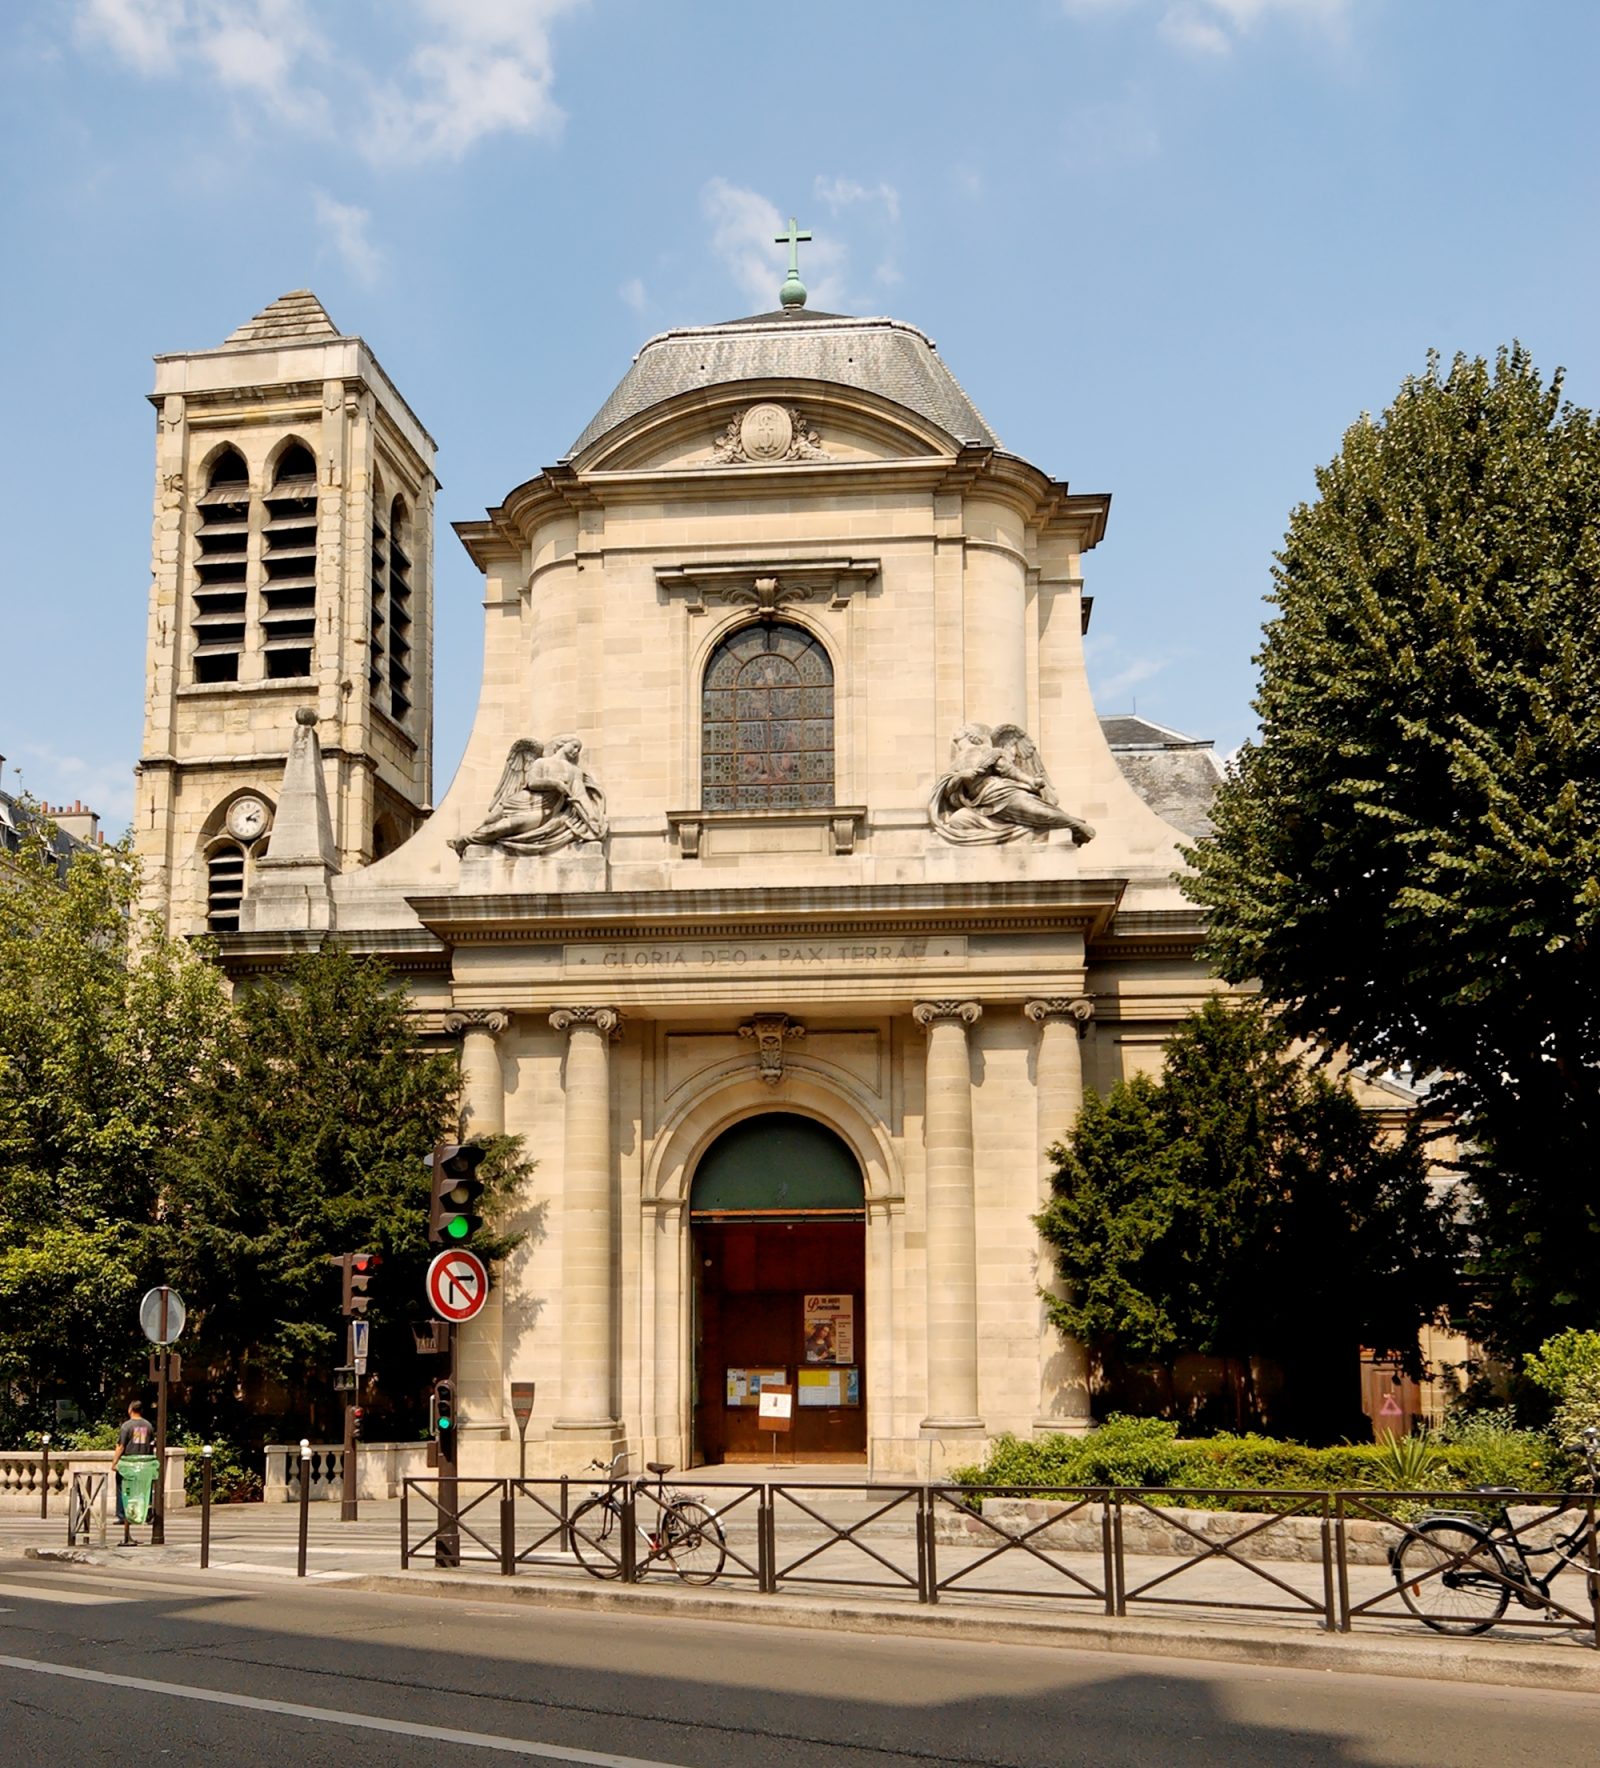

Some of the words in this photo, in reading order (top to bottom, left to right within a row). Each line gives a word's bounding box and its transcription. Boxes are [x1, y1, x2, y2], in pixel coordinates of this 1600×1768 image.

[602, 951, 688, 969] GLORIA
[702, 949, 748, 967] DEO
[778, 947, 825, 965] PAX
[838, 945, 927, 963] TERRAE
